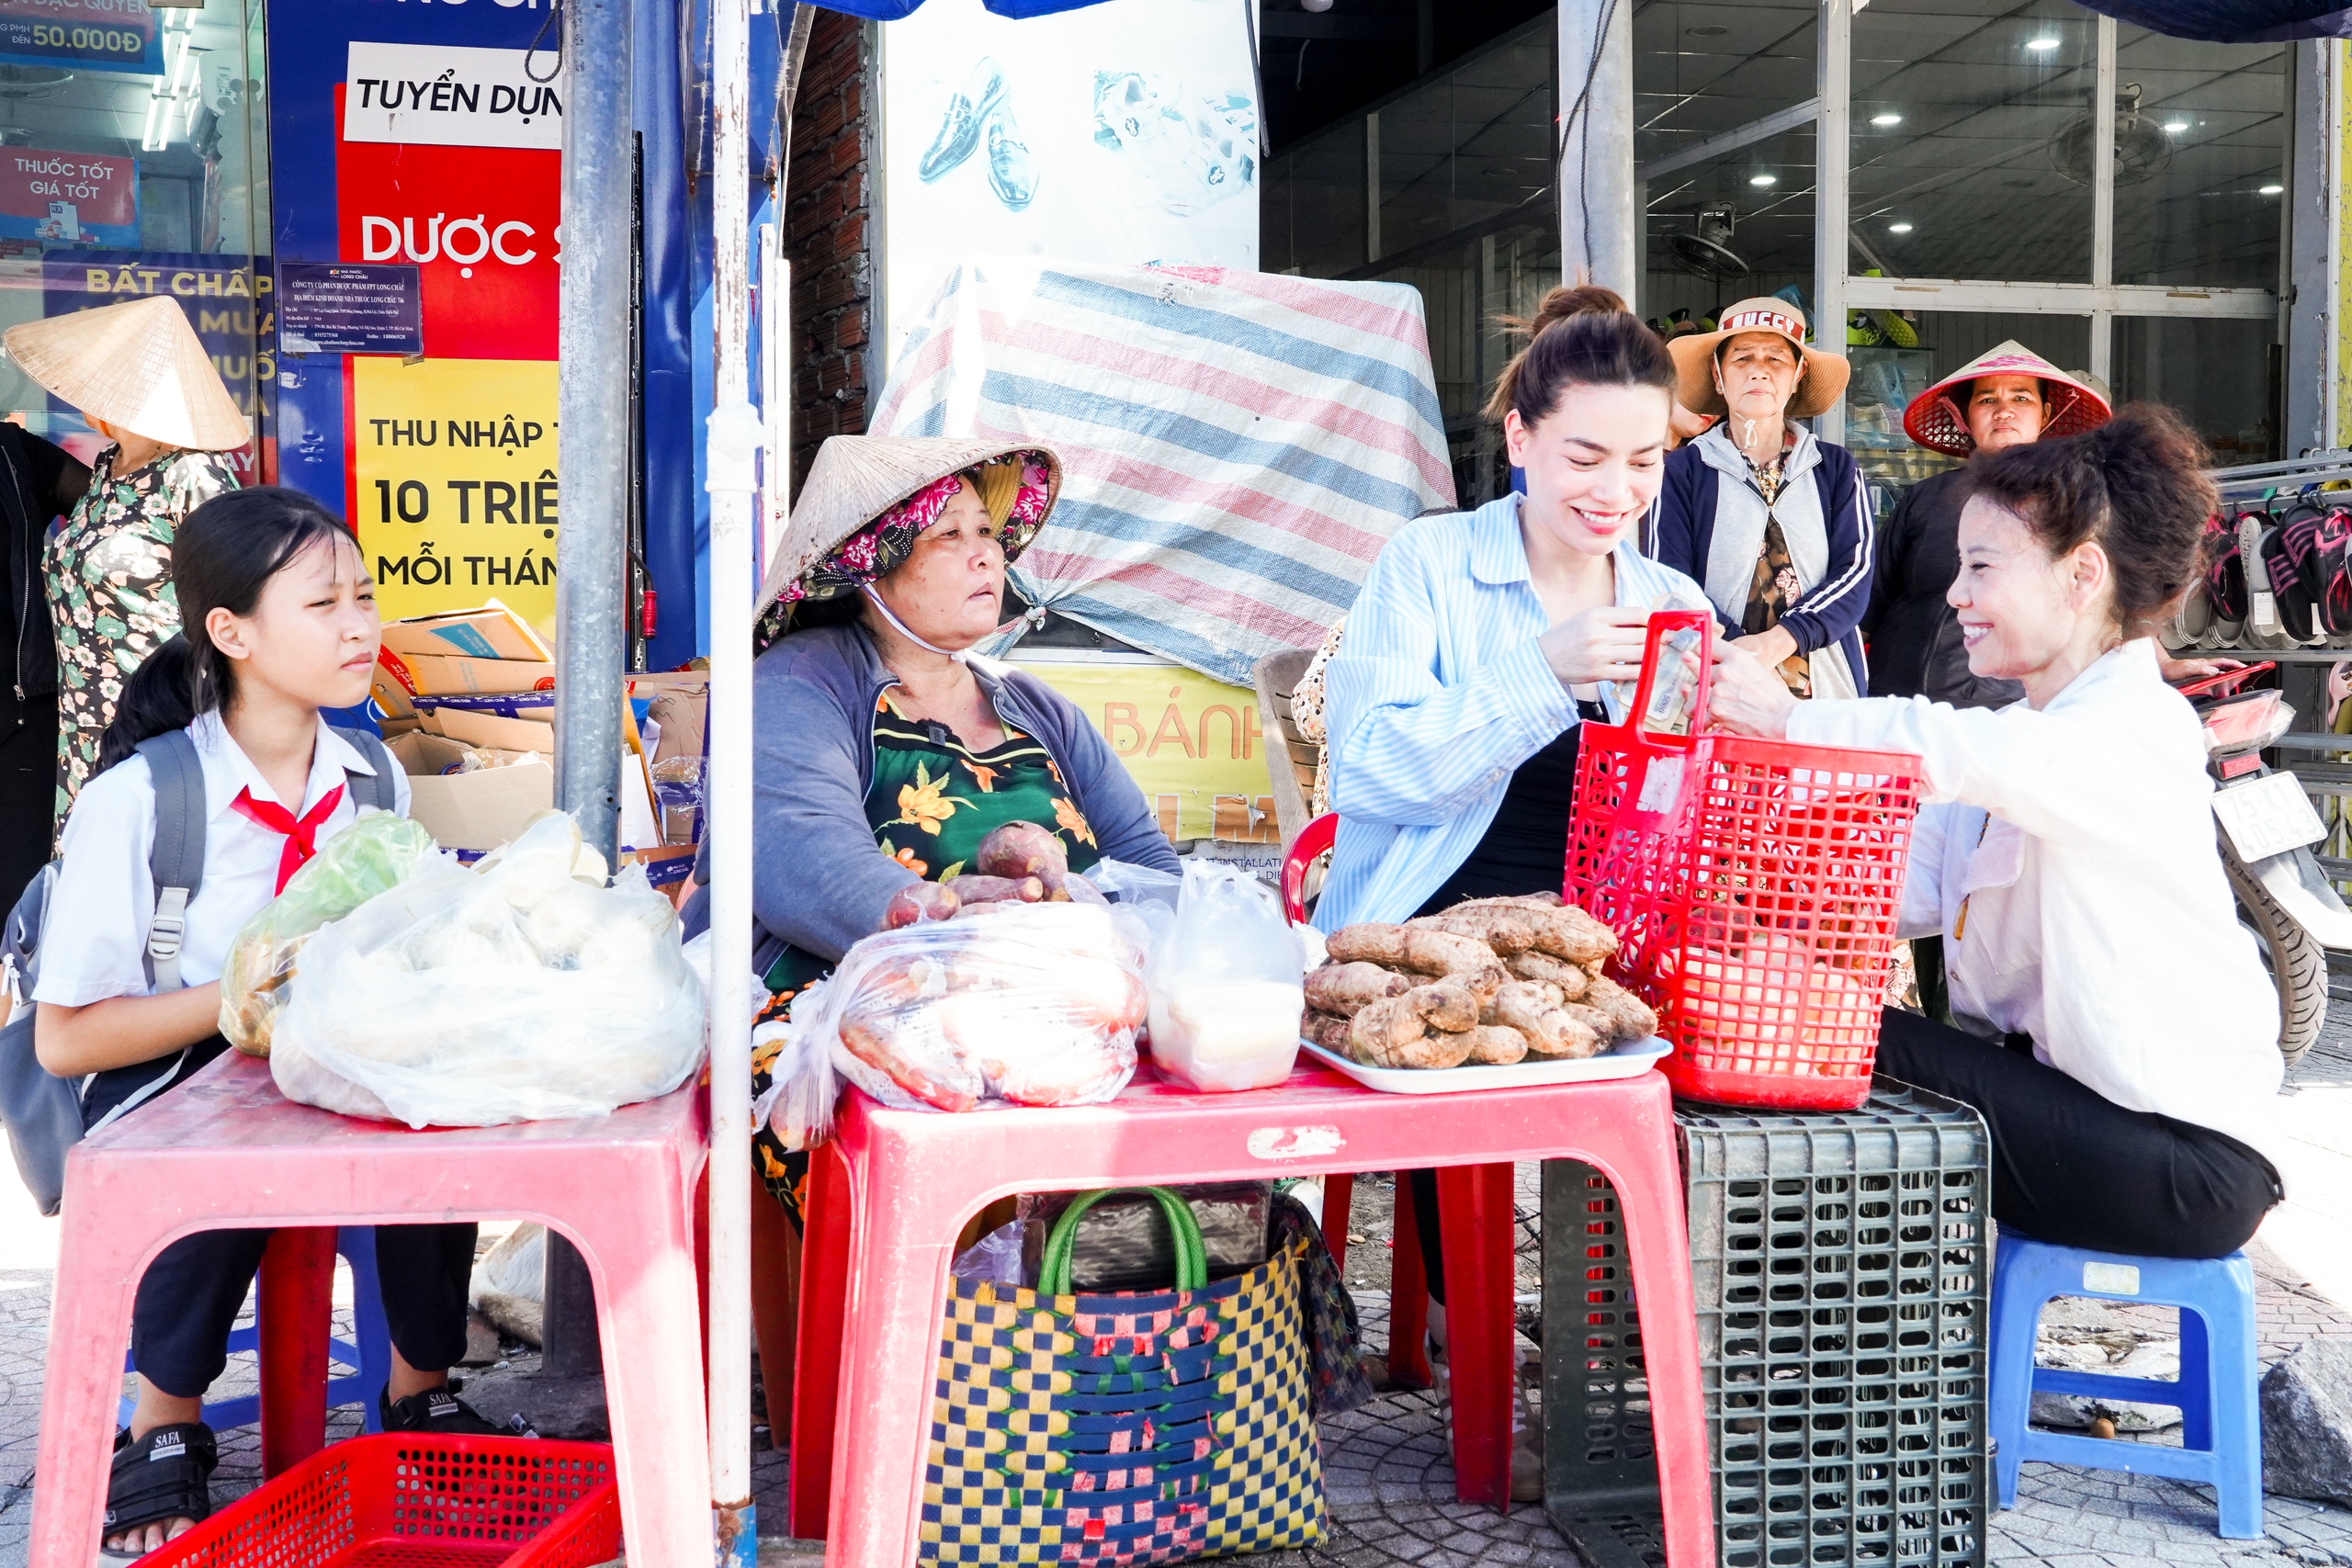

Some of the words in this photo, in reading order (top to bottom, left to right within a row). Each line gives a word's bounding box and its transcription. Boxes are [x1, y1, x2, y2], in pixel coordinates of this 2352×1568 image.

[10, 24, 29, 33] PMH
[12, 33, 30, 44] ĐẾN
[33, 25, 141, 52] 50.000Đ
[357, 69, 481, 113] TUYỂN
[489, 85, 562, 125] DỤN
[15, 157, 75, 176] THUỐC
[79, 162, 114, 180] TỐT
[29, 180, 61, 196] GIÁ
[65, 180, 99, 199] TỐT
[361, 212, 537, 279] DƯỢC
[86, 262, 161, 294] BẤT
[171, 265, 273, 299] CHẤP
[292, 279, 307, 288] CÔNG
[1732, 311, 1794, 334] GUCCY
[369, 419, 437, 446] THU
[447, 413, 543, 457] NHẬP
[375, 479, 429, 524] 10
[447, 468, 559, 539] TRIỆ
[378, 541, 451, 585] MỖI
[463, 548, 558, 585] THÁN
[1220, 857, 1281, 868] INSTALLATI
[429, 1393, 452, 1405] SAFA
[154, 1430, 181, 1449] SAFA
